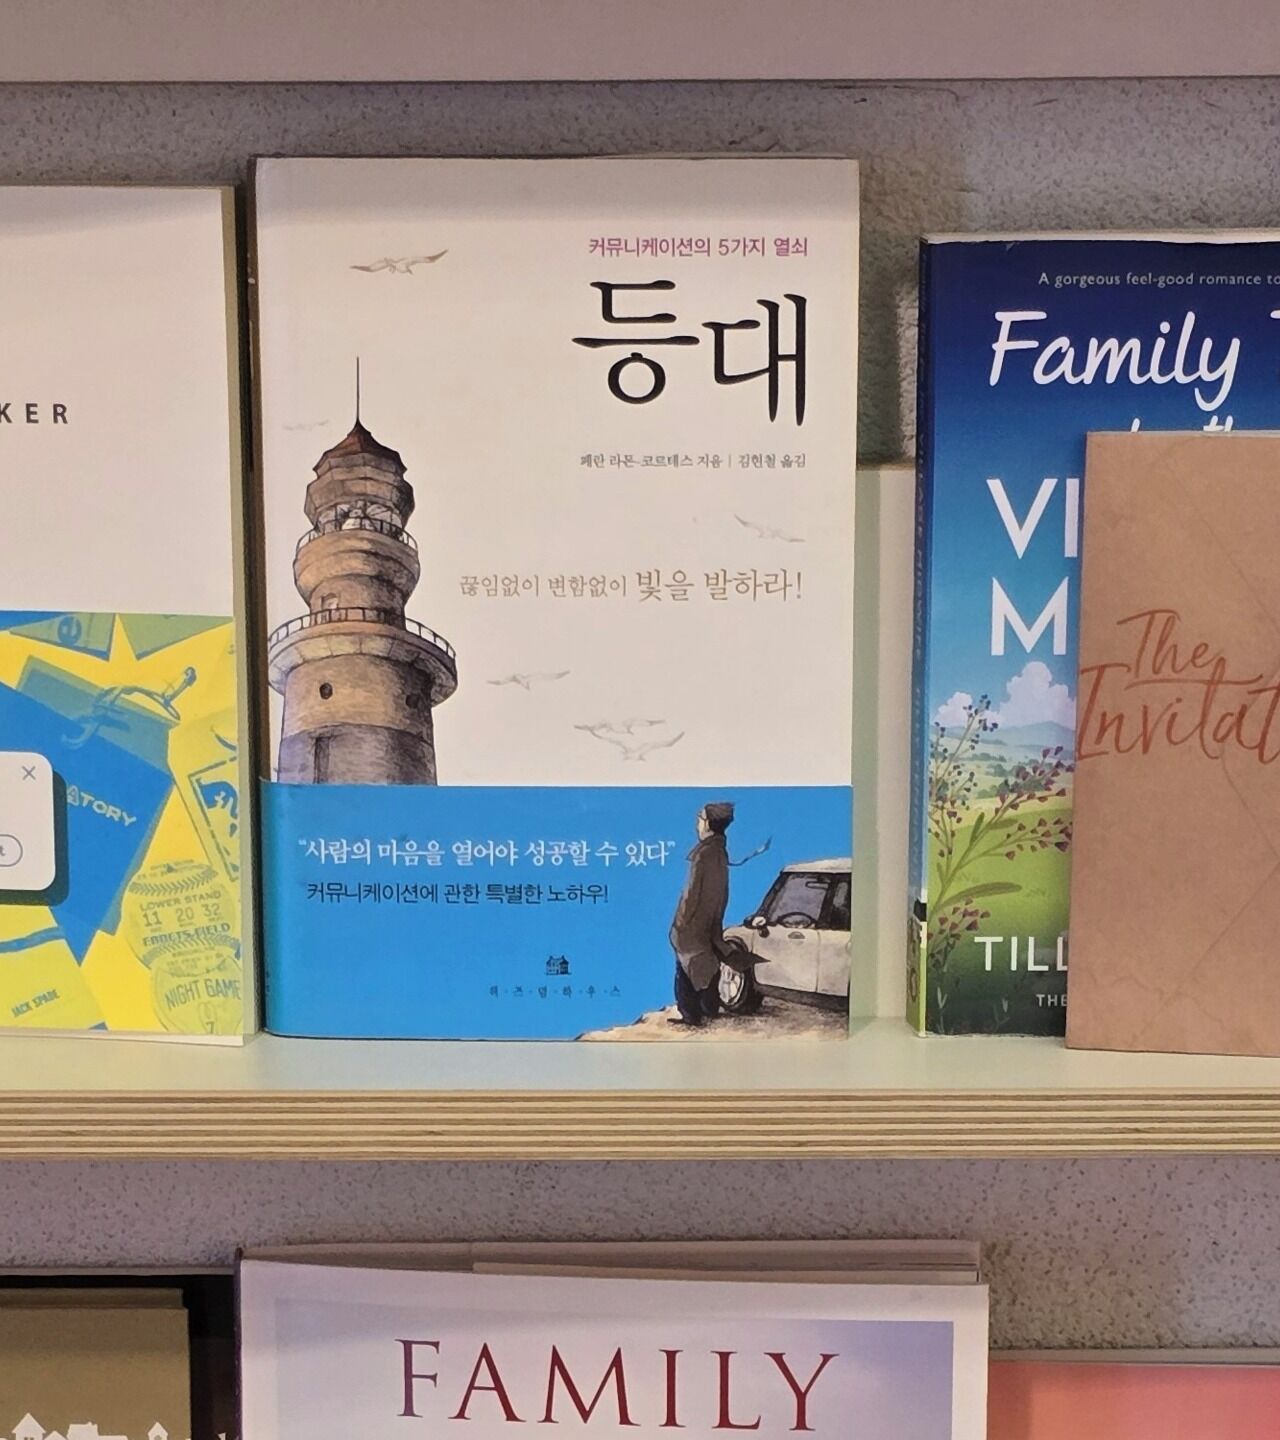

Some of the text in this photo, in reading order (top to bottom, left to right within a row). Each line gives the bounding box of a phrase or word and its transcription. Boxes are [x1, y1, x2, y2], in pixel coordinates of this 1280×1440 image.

[588, 236, 809, 258] 커뮤니케이션의 5가지 열쇠
[1038, 271, 1050, 285] A
[1054, 273, 1121, 288] gorgeous
[1125, 272, 1195, 288] feel-good
[1199, 273, 1262, 286] romance
[571, 279, 808, 427] 등대
[987, 309, 1241, 413] Family
[697, 453, 807, 469] 지음 옮김
[460, 568, 803, 602] 끊임없이 변함없이 빛을 발하라!
[1116, 607, 1221, 680] The
[377, 838, 620, 868] 마음을 열어야 성공할 수
[140, 889, 222, 912] LOWER STAND
[306, 881, 609, 905] 커뮤니케이션에 관한 특별한 노하우!
[142, 902, 221, 927] 11 20 32
[394, 1338, 840, 1433] FAMILY
